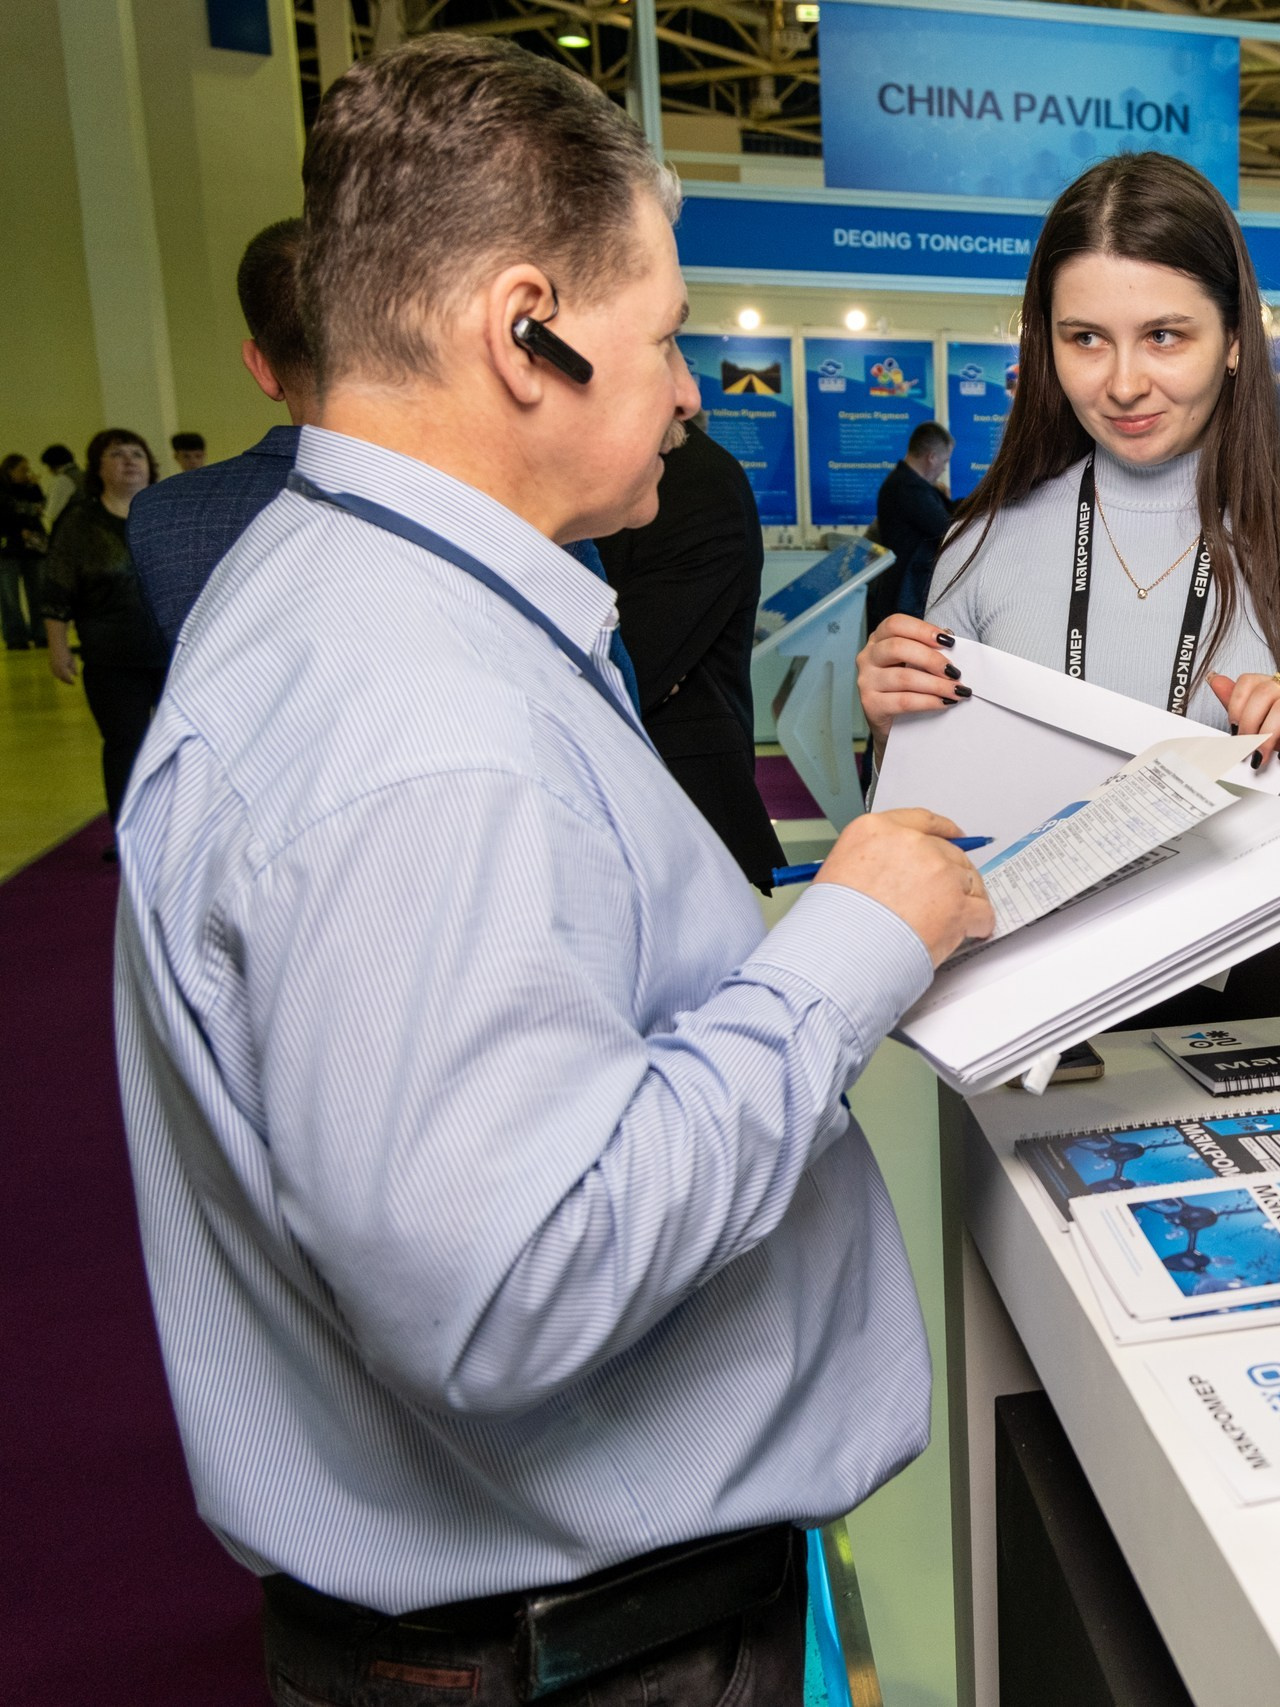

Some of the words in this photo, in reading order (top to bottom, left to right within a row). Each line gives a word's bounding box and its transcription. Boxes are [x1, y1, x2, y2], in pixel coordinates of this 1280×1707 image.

[877, 82, 1004, 121] CHINA
[1014, 92, 1191, 135] PAVILION
[833, 228, 911, 250] DEQING
[919, 232, 1031, 255] TONGCHEM
[838, 411, 872, 421] Organic
[874, 411, 909, 421] Pigment
[1193, 538, 1211, 598] ОМЕР
